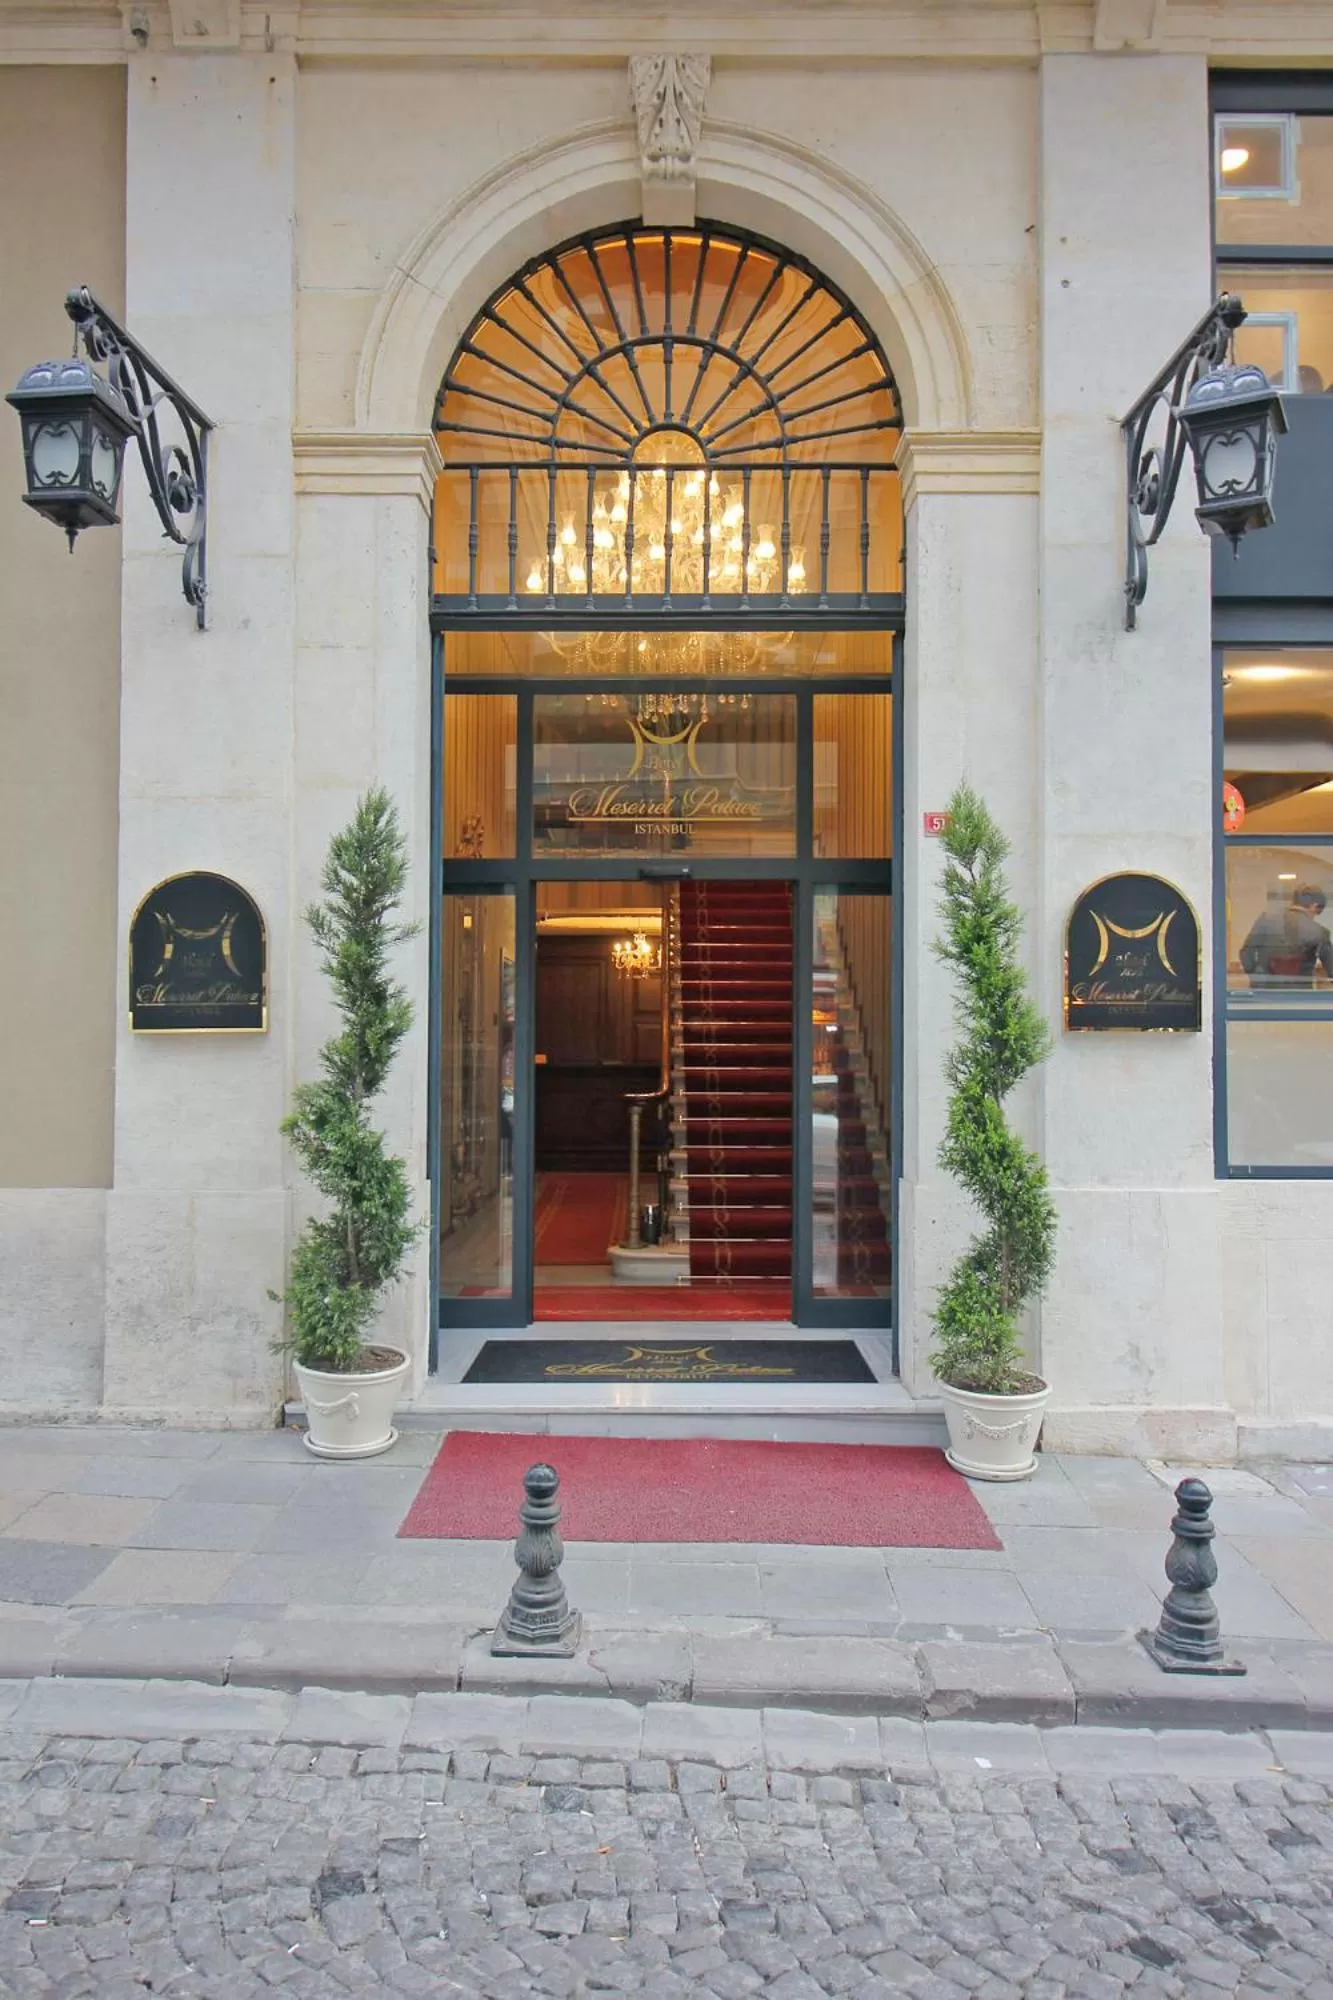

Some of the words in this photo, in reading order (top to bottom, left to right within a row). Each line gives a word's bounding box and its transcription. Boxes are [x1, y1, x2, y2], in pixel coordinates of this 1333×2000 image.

[568, 784, 673, 817] Meserret
[682, 786, 762, 817] Palace
[635, 823, 695, 835] ISTANBUL
